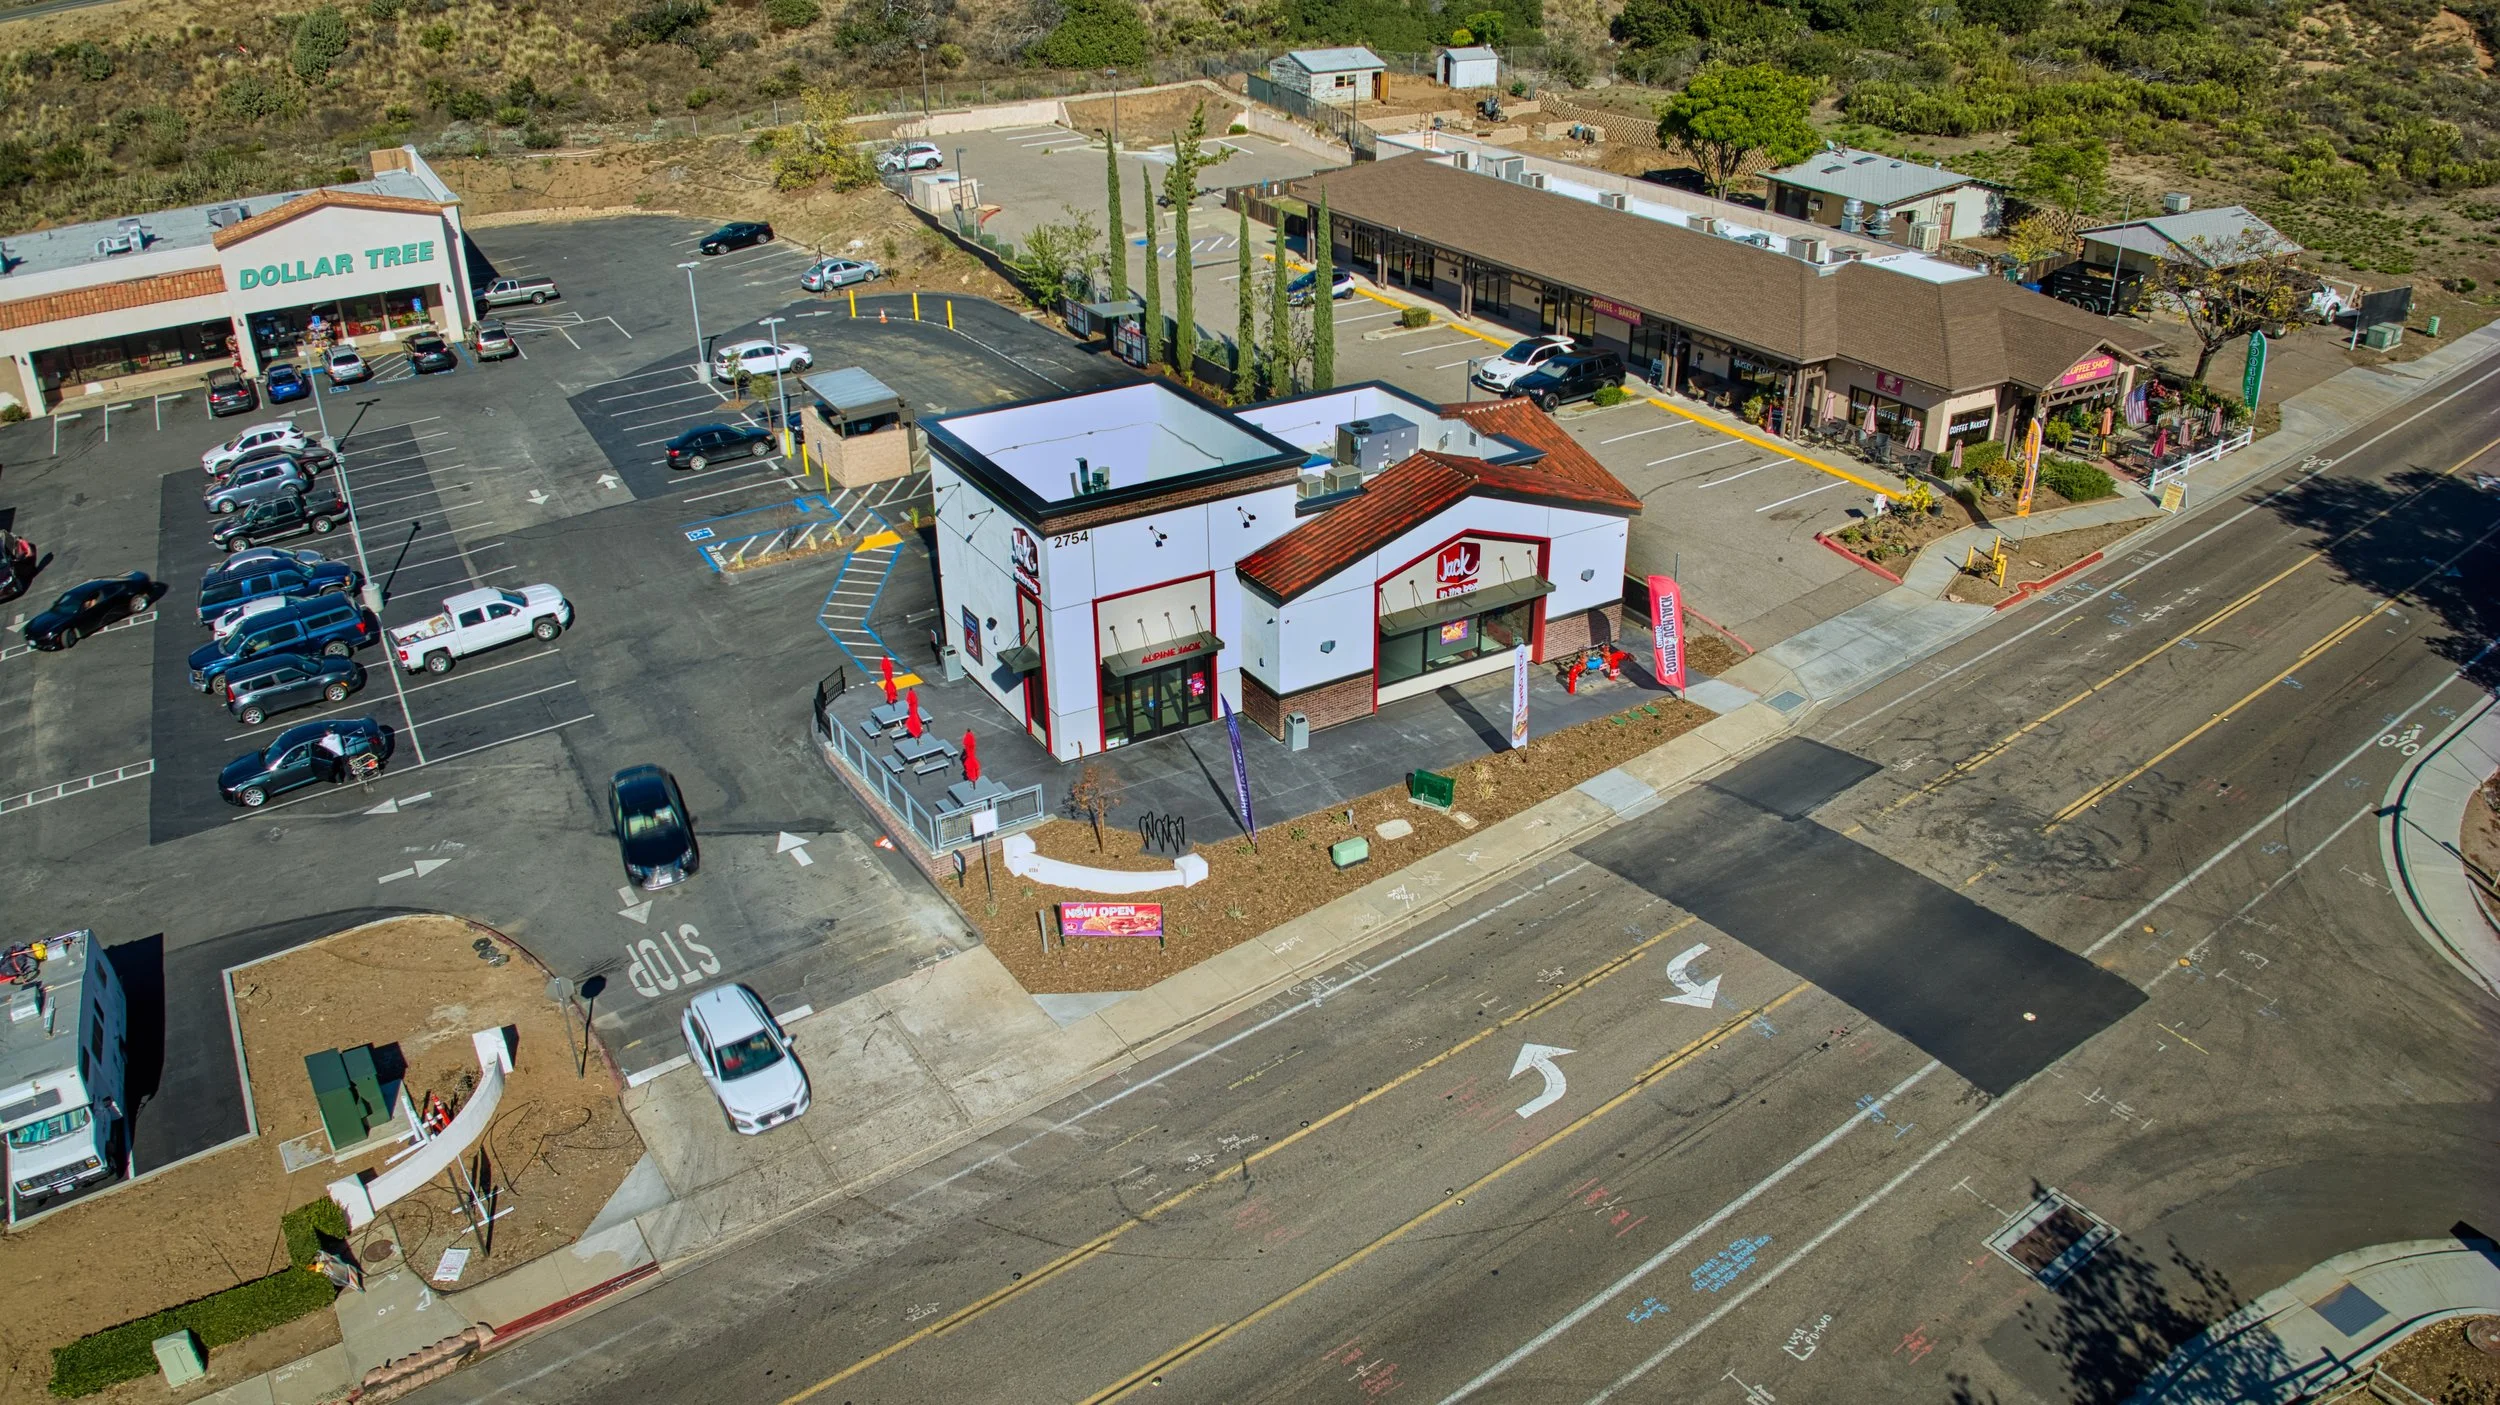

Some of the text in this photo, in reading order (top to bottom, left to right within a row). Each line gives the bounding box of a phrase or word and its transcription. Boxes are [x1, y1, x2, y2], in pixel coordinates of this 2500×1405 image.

[240, 241, 434, 290] DOLLAR TREE
[1593, 298, 1613, 312] COFFEE
[1618, 306, 1641, 321] BAKERY
[2092, 359, 2110, 370] SHOP
[2076, 371, 2097, 381] BAKERY
[1877, 408, 1899, 421] COFFEE
[1949, 418, 1990, 435] COFFEE BAKERY
[1054, 530, 1089, 549] 2754
[1439, 546, 1480, 582] Jack
[1141, 641, 1201, 665] ALPINE JACK
[1065, 906, 1136, 919] NOW OPEN
[626, 923, 721, 998] STOP
